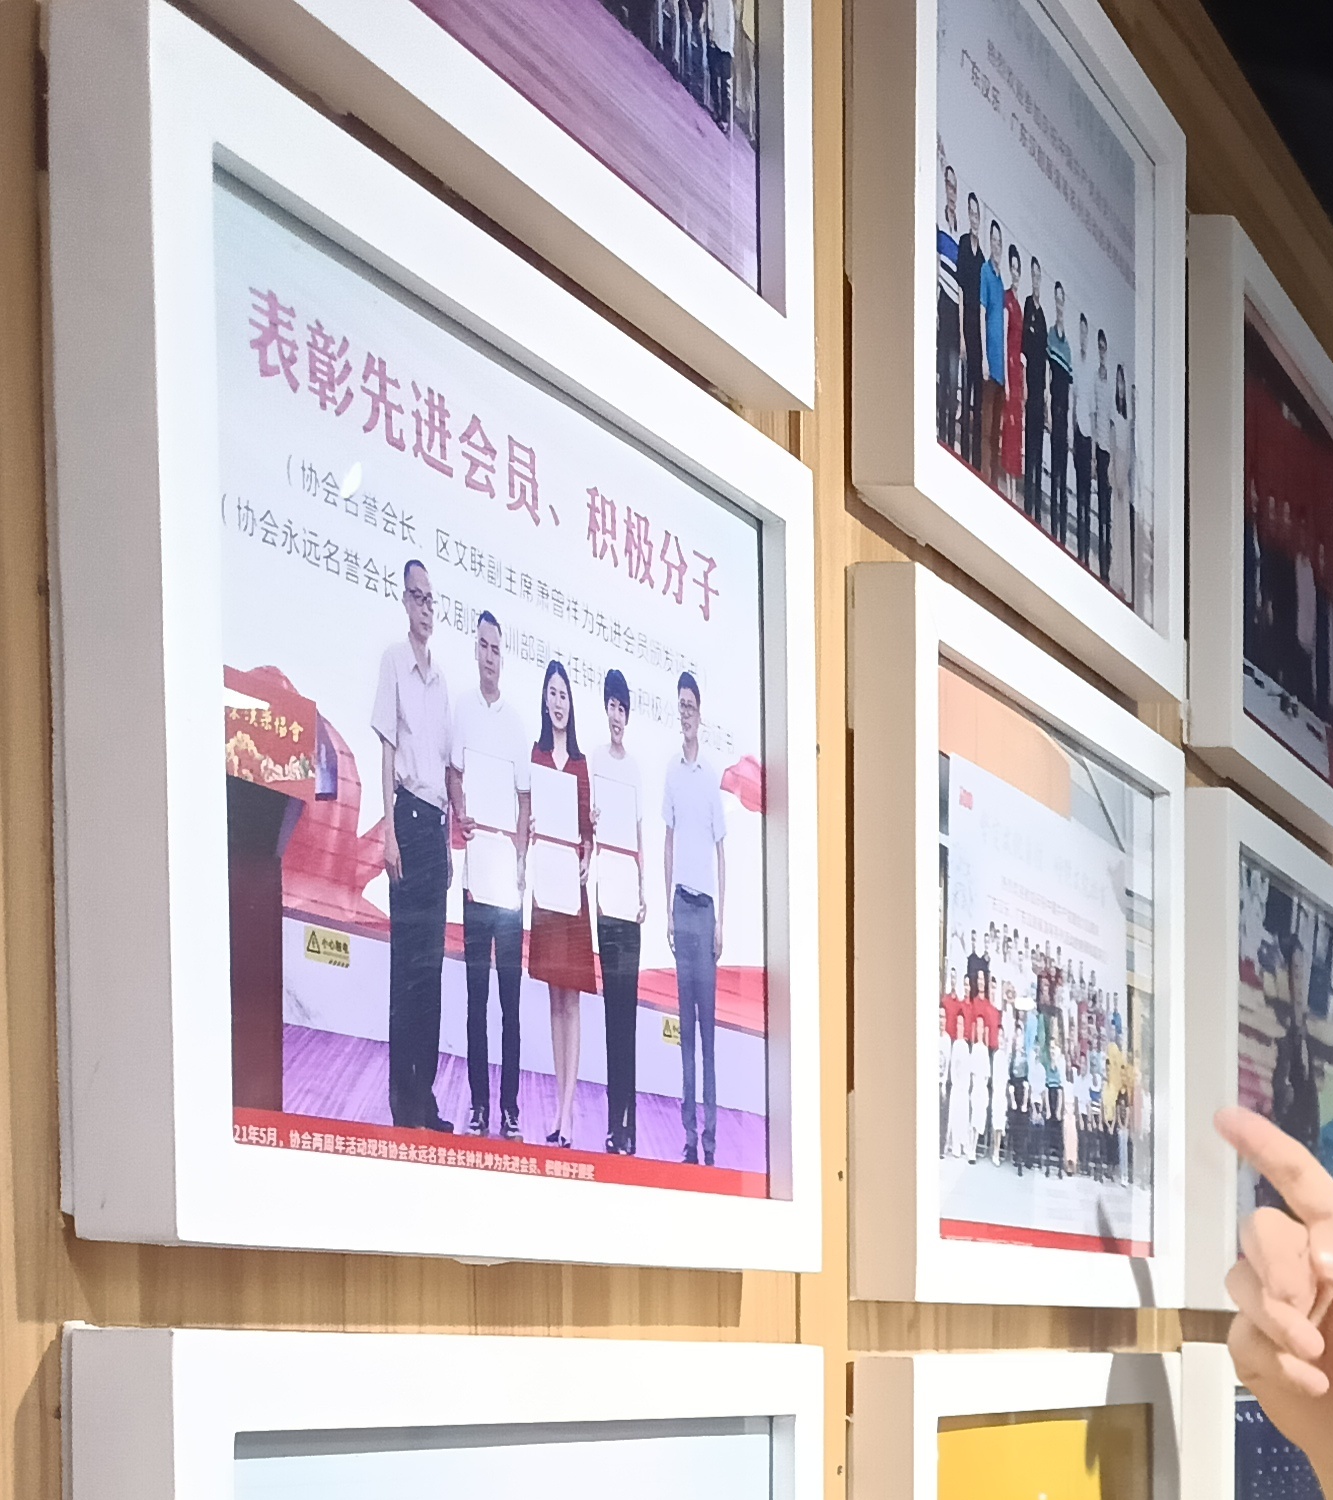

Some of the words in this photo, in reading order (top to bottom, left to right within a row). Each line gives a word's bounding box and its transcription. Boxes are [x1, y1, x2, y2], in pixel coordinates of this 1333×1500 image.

[248, 286, 720, 622] 表彰先进会员、积极分子
